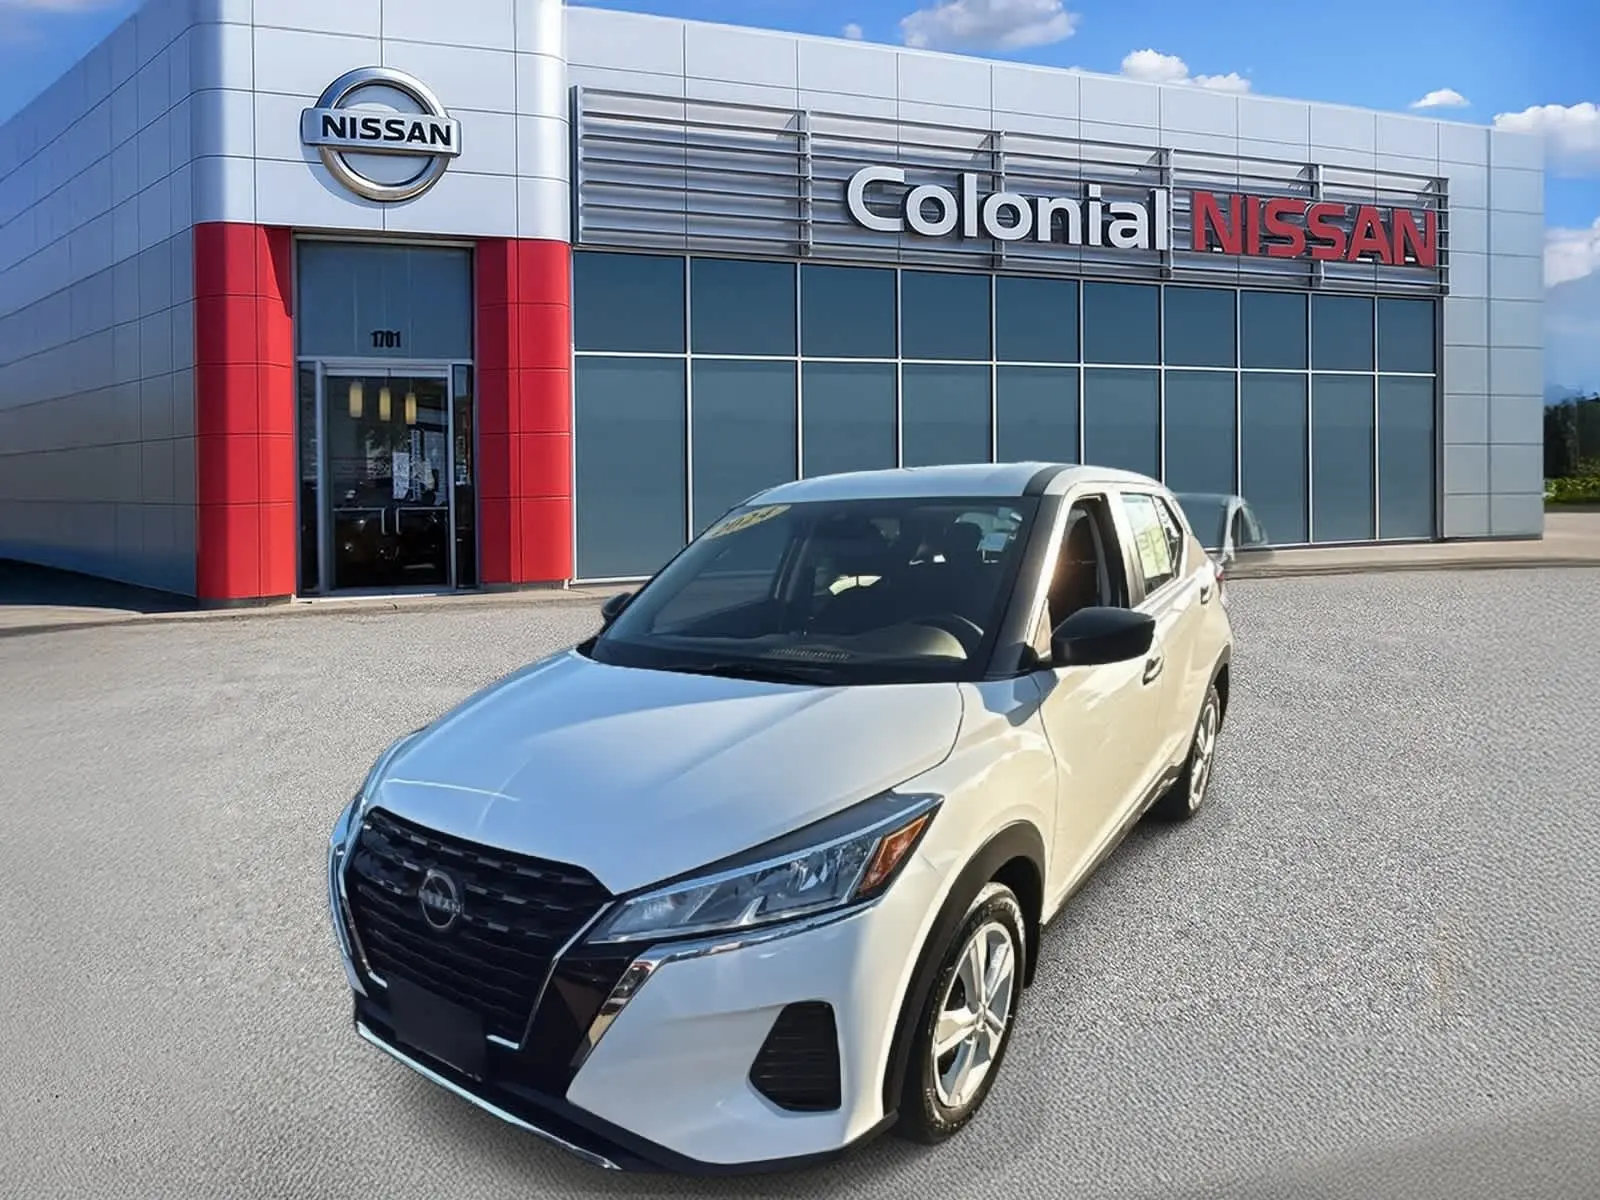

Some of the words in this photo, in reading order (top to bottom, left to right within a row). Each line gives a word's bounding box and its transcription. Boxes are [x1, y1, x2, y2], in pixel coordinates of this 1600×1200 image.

[321, 114, 451, 146] NISSAN
[846, 165, 1168, 251] Colonial
[1192, 191, 1437, 267] NISSAN
[370, 330, 402, 348] 1701
